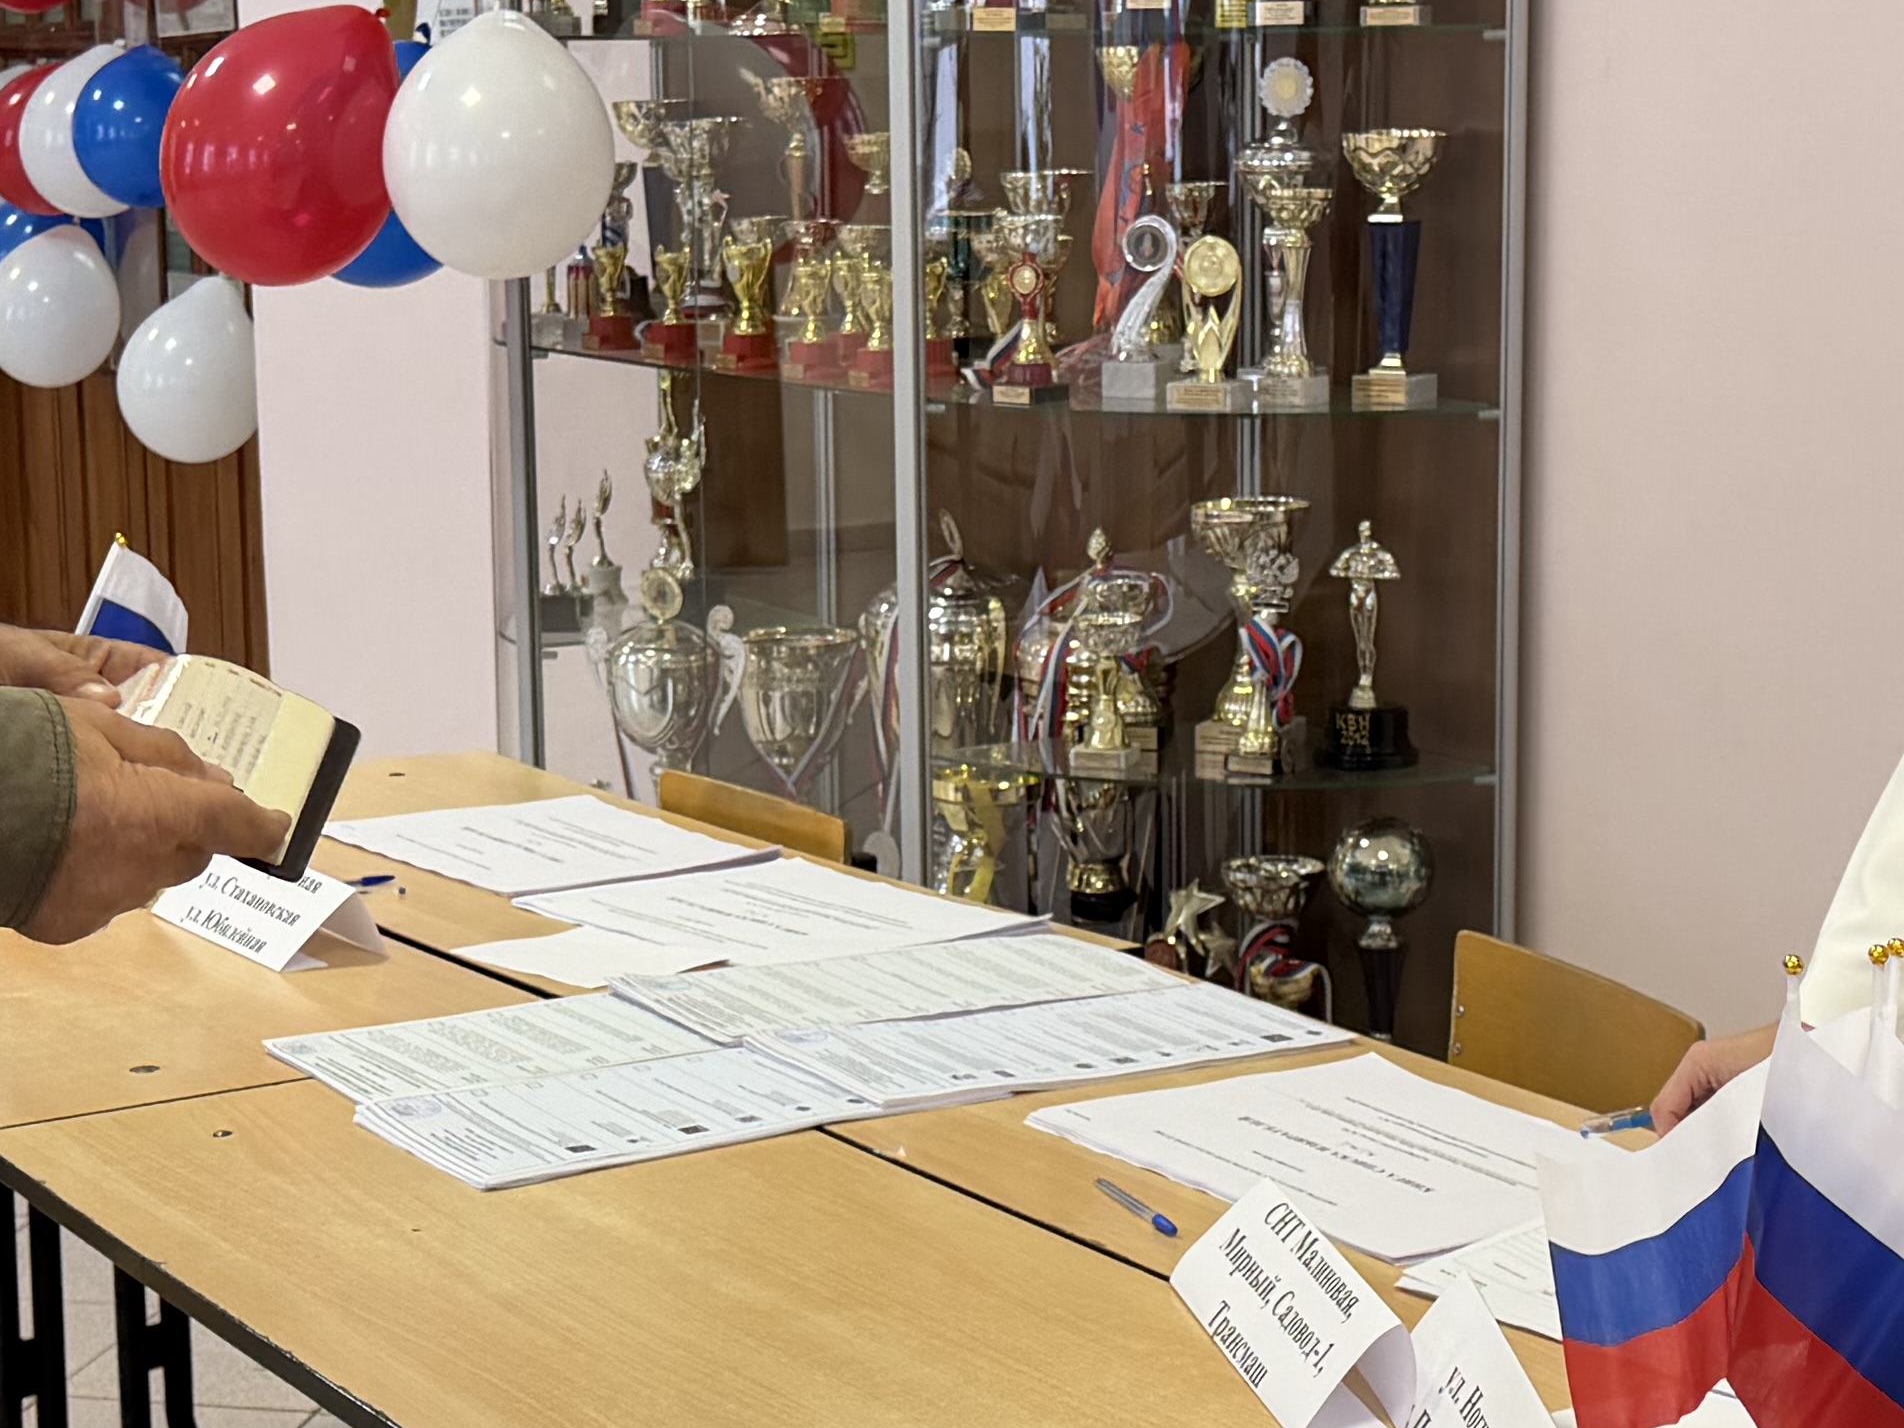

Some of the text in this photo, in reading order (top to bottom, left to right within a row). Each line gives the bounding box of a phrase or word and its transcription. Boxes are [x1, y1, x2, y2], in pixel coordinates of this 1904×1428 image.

[221, 876, 300, 927] Стахановская
[1219, 1228, 1334, 1376] Мирный, Садовод-1,
[1264, 1202, 1360, 1323] СНТ Малиновая,
[1206, 1300, 1268, 1389] Трансмаш
[1438, 1366, 1462, 1402] ул.
